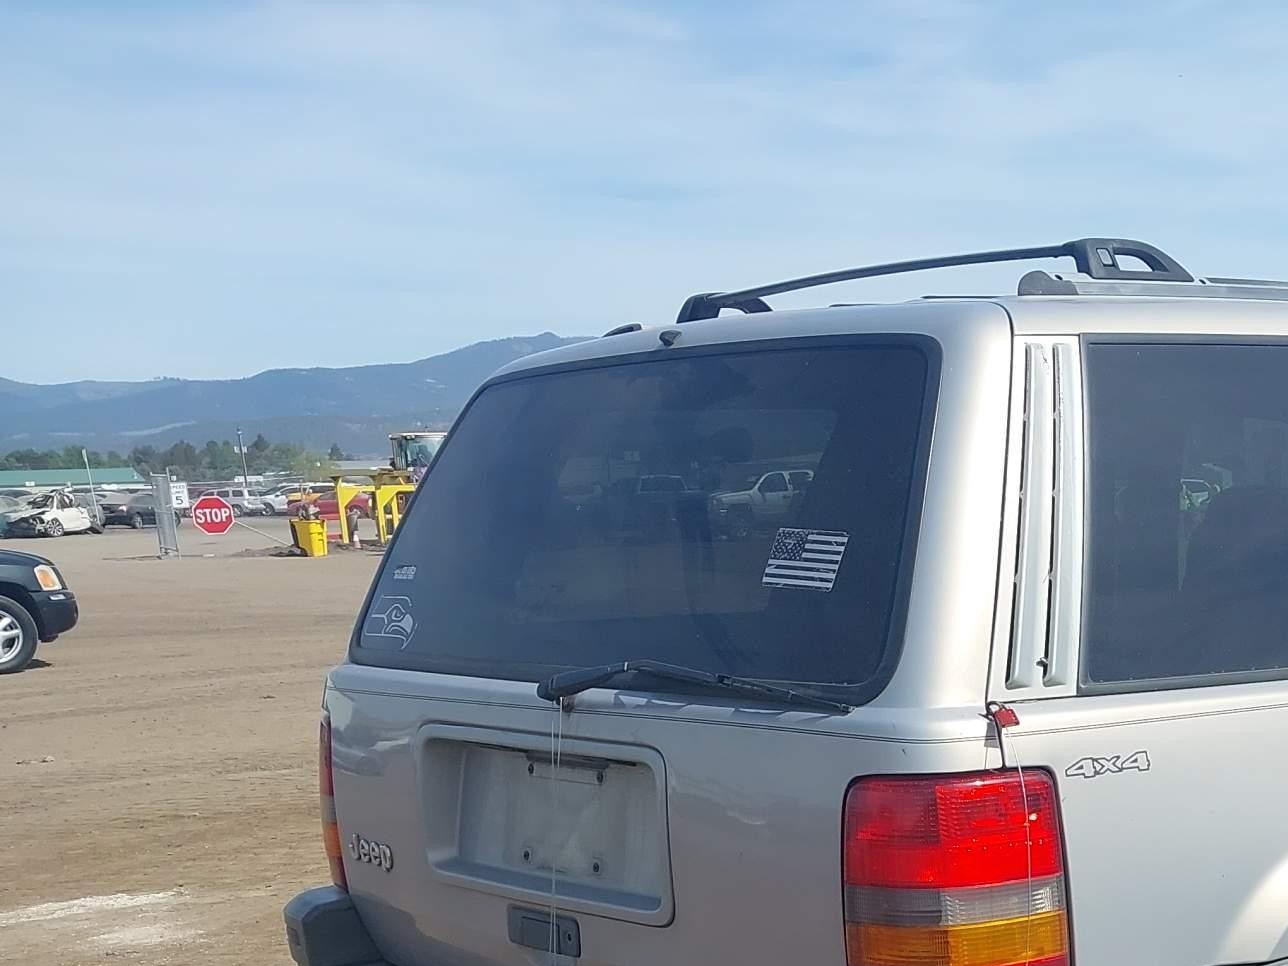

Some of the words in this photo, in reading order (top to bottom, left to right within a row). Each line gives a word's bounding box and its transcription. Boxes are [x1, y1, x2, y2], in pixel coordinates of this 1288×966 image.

[175, 495, 184, 505] 5
[195, 508, 230, 524] STOP
[348, 832, 394, 872] Jeep
